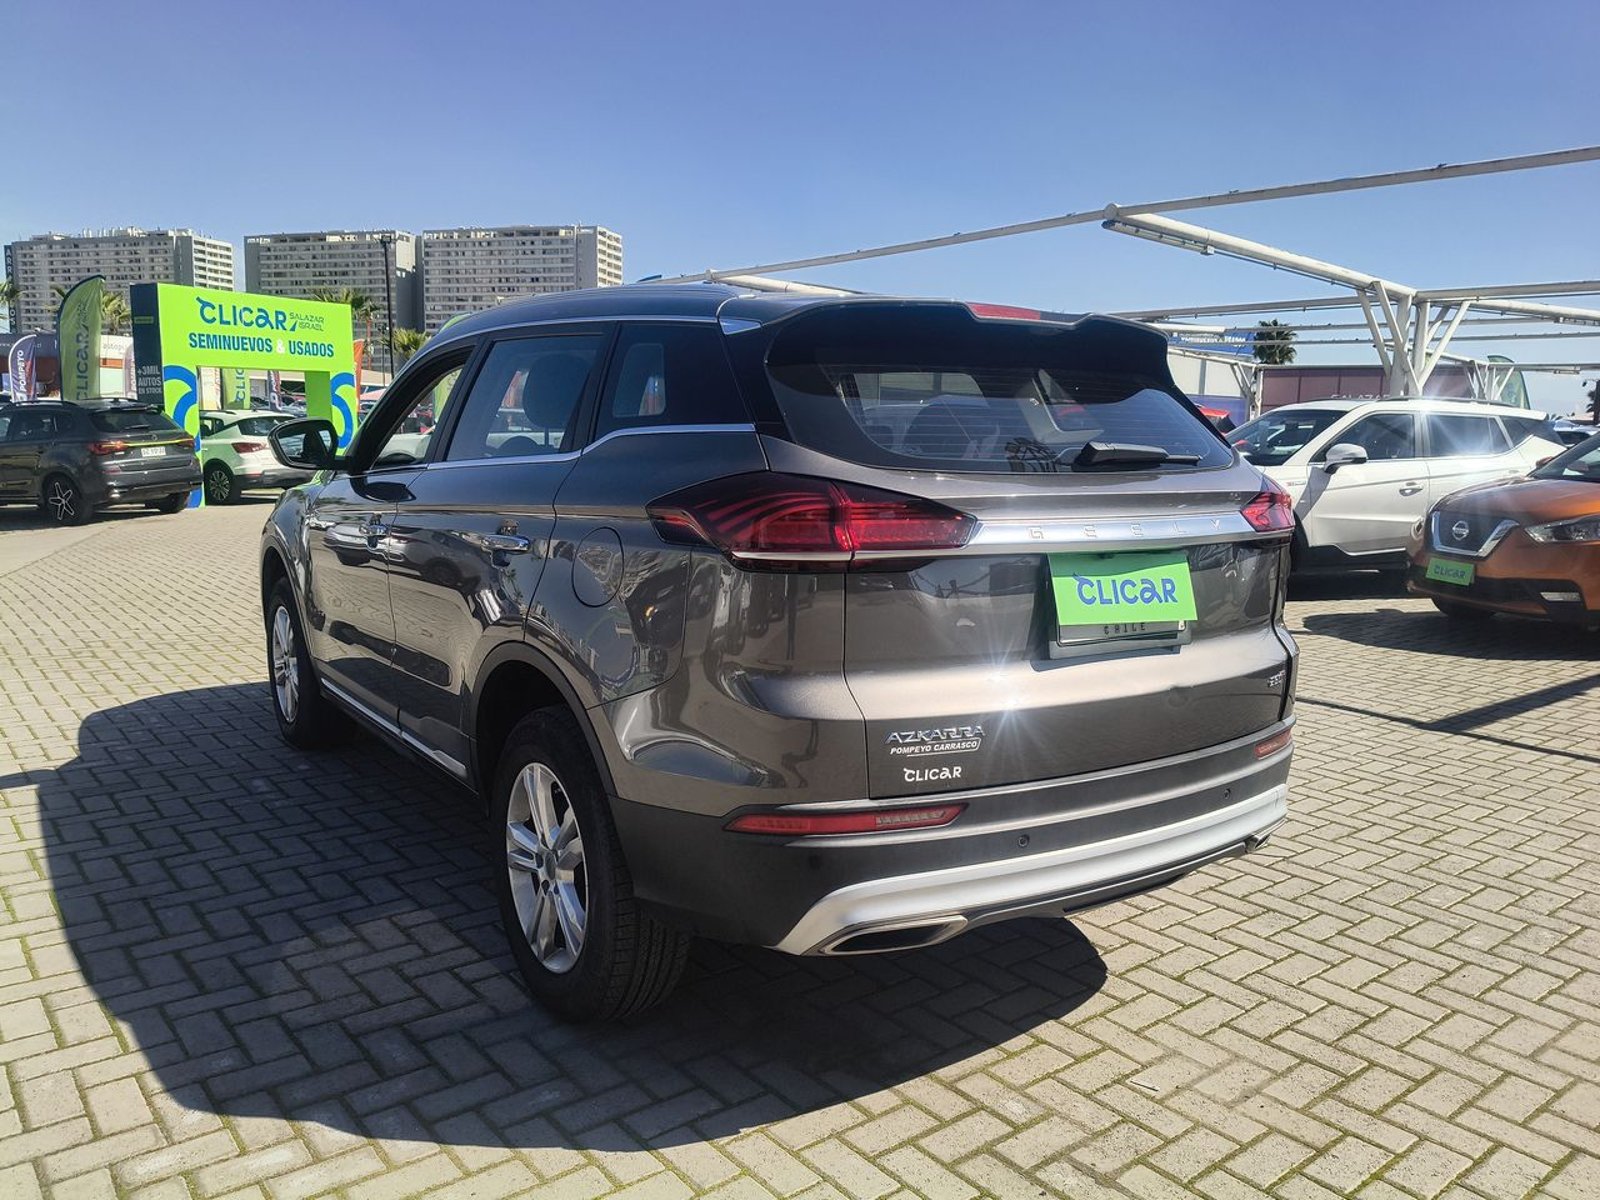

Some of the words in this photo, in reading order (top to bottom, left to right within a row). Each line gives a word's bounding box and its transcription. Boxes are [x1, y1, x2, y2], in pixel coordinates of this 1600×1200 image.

[195, 296, 287, 331] CLICAR
[289, 311, 325, 324] SALAZAR
[298, 321, 324, 332] ISRAEL
[188, 332, 273, 353] SEMINUEVOS
[276, 339, 286, 354] &
[288, 340, 335, 358] USADOS
[17, 349, 28, 392] POMPEYO
[138, 377, 162, 387] AUTOS
[1026, 519, 1221, 540] GEELY
[1073, 572, 1178, 606] CLICAR
[1103, 622, 1146, 635] CHILE
[884, 725, 986, 744] AZKARRA
[889, 744, 932, 755] POMPEYO
[933, 740, 977, 751] CARRASCO
[903, 766, 962, 782] CLICAR
